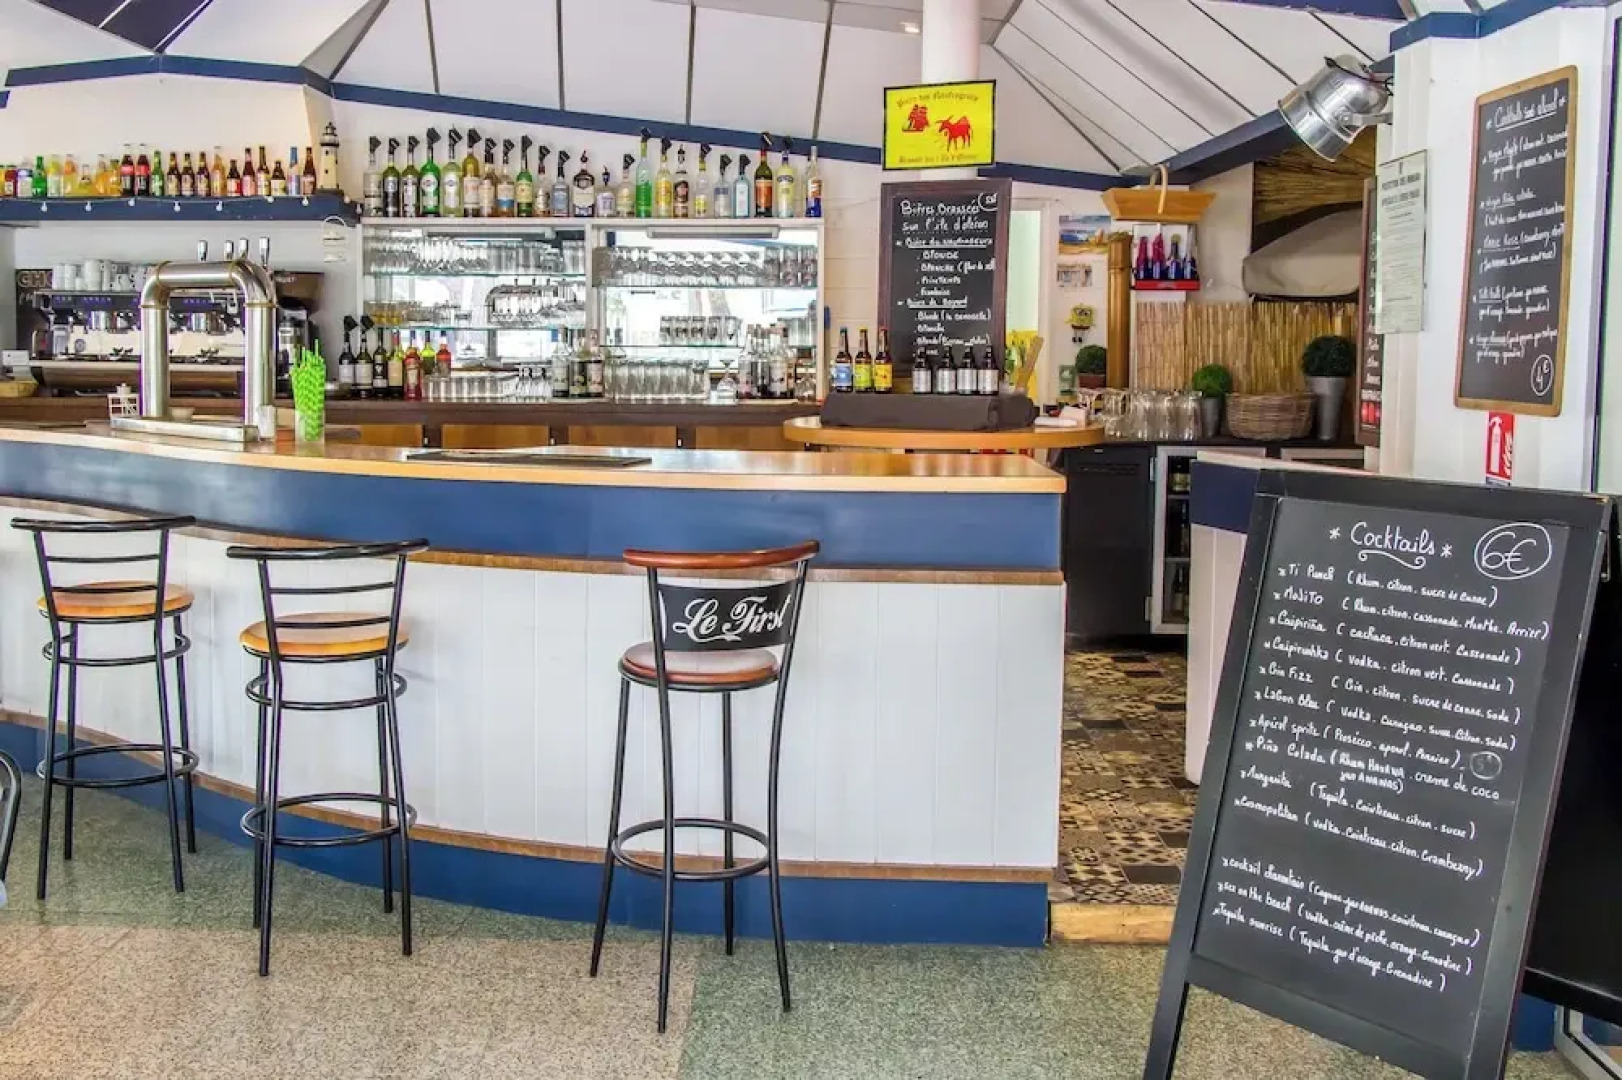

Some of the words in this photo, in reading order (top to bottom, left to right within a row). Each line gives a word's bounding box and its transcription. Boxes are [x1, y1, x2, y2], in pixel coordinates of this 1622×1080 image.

[1350, 521, 1436, 556] Cocktails
[1482, 531, 1537, 574] 6€
[672, 597, 722, 644] Le
[721, 593, 792, 636] First
